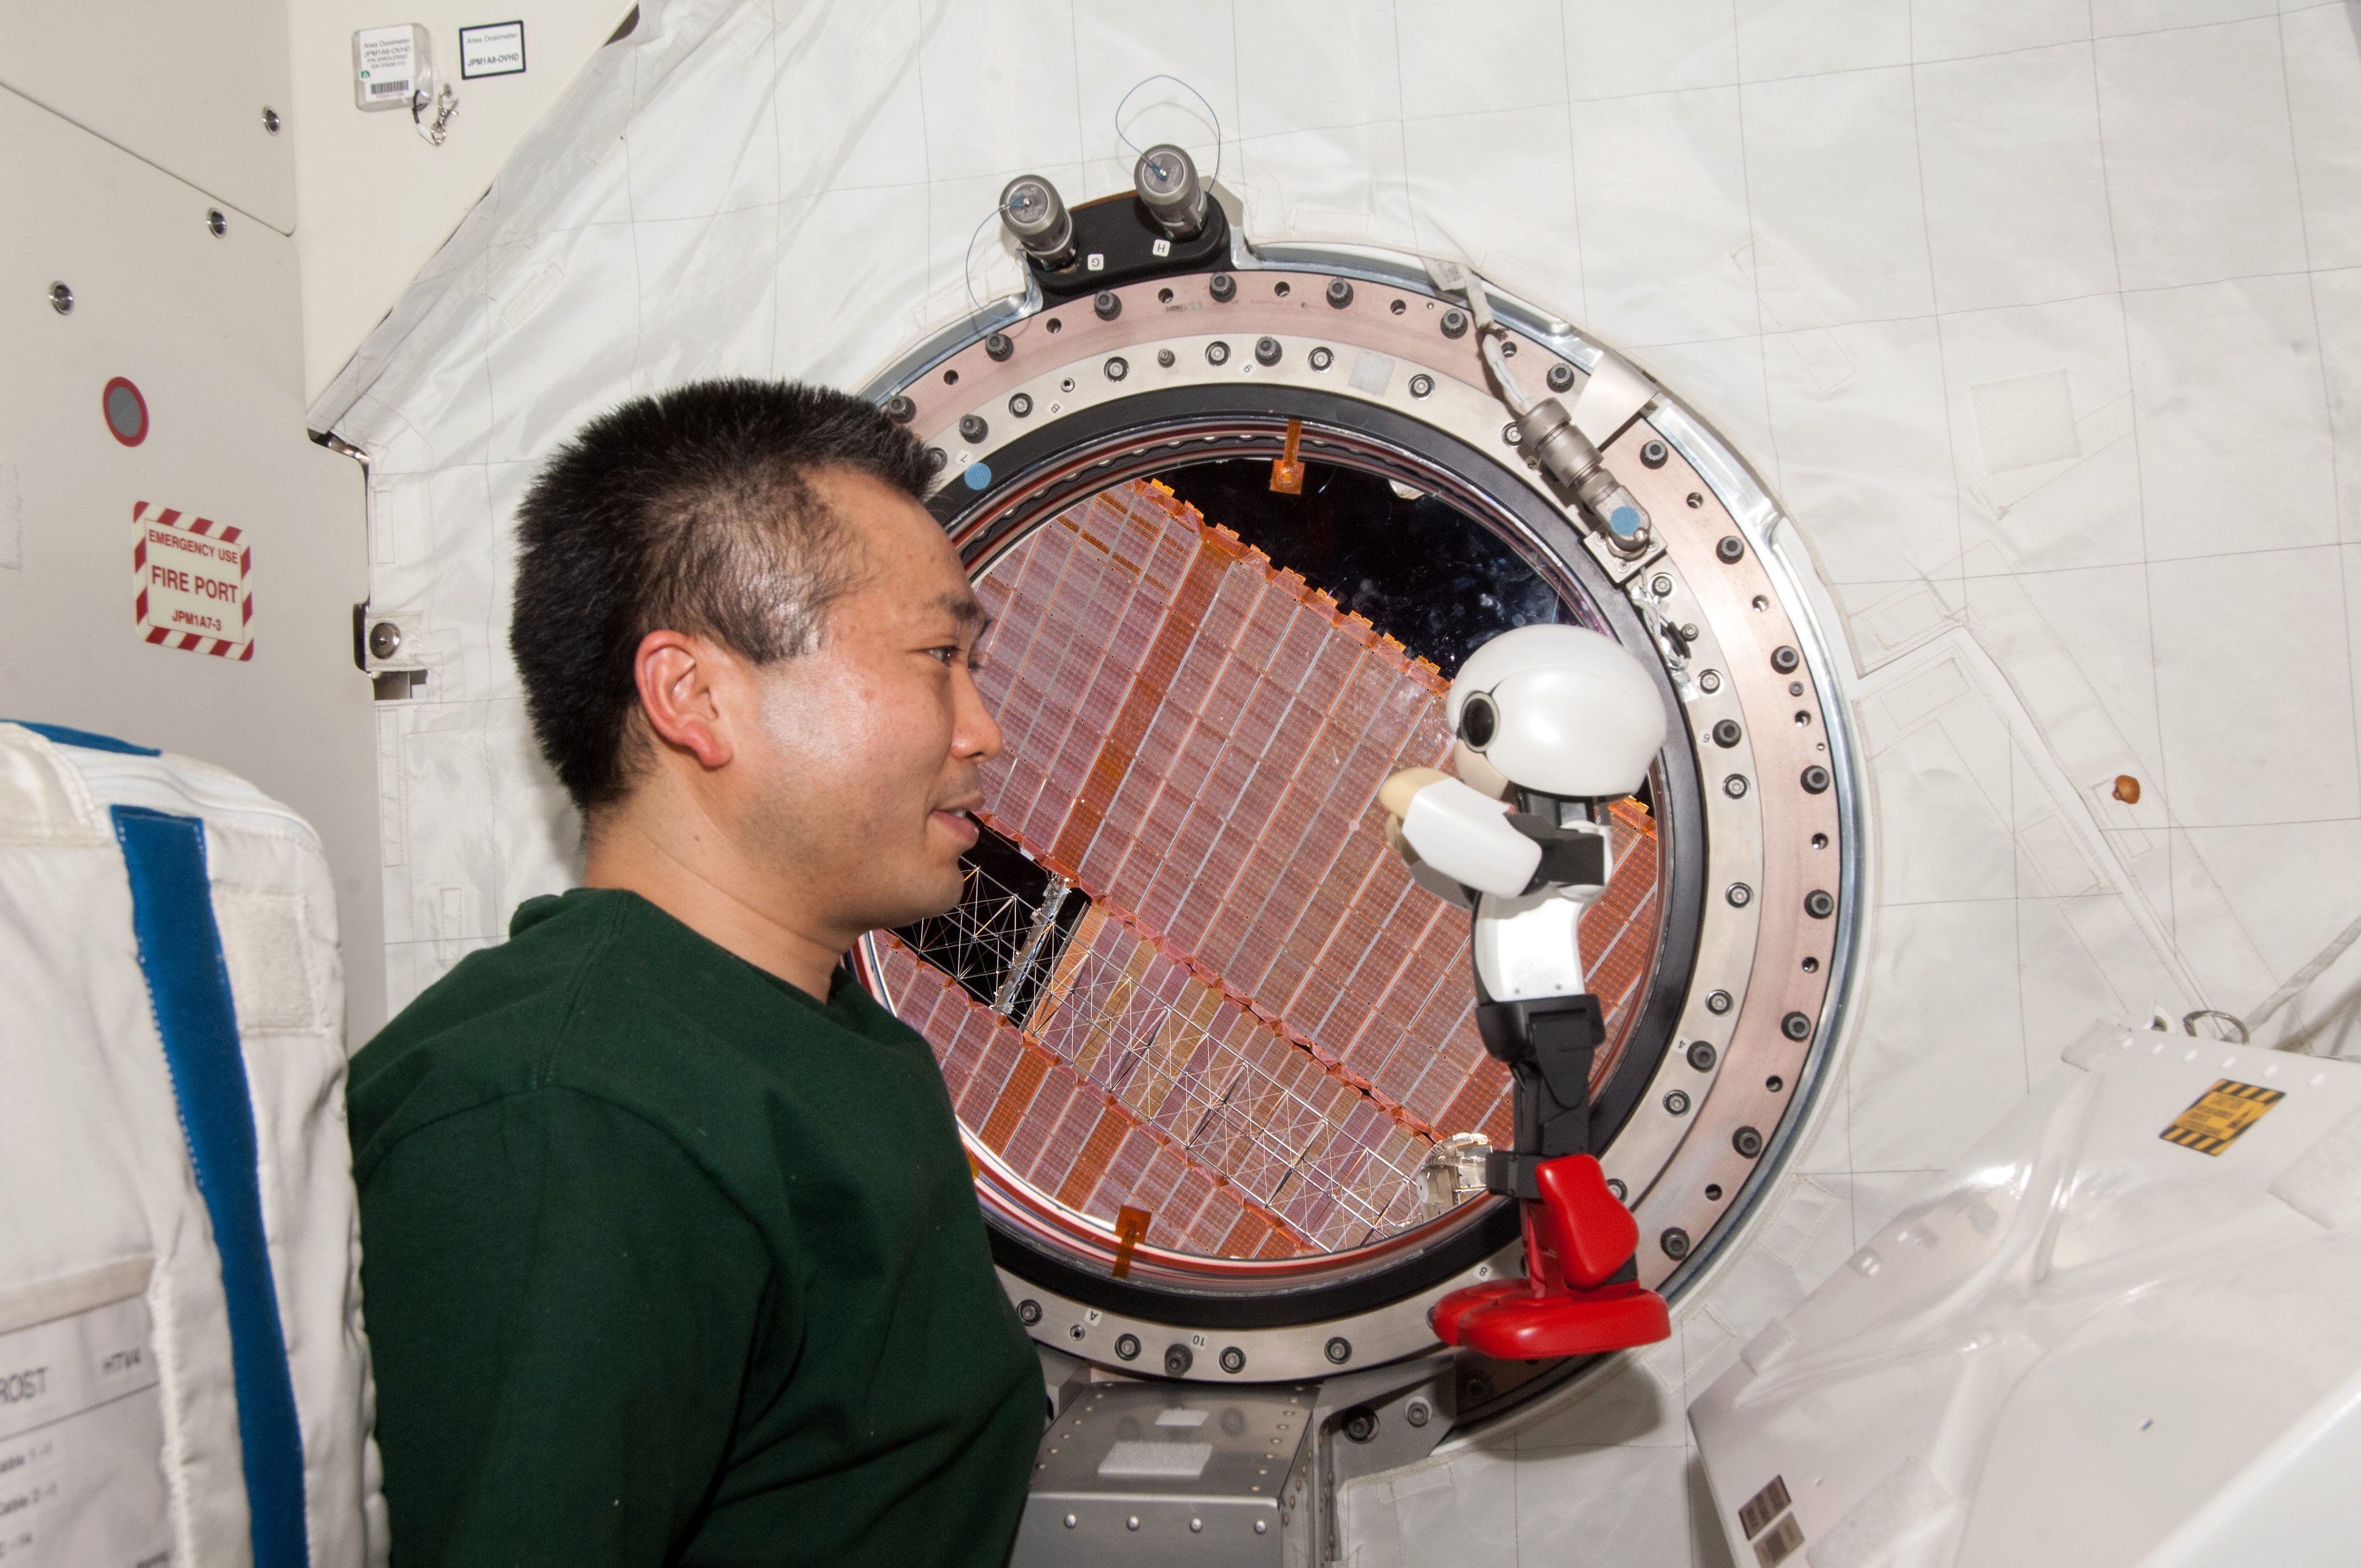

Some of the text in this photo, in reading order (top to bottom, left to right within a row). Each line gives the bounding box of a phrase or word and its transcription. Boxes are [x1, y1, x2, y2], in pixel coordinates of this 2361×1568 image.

[484, 33, 518, 42] Dosimeter
[379, 39, 410, 47] Dosimeter
[467, 52, 519, 67] JPM1A8-OVHD
[1157, 243, 1166, 252] H
[1091, 258, 1100, 267] G
[960, 454, 967, 463] 7
[149, 529, 239, 565] EMERGENCY USE
[151, 565, 238, 604] FIRE PORT
[172, 609, 222, 631] JPM1A7-3
[1678, 1040, 1687, 1049] 4
[1479, 1267, 1488, 1276] 8
[1090, 1310, 1099, 1321] A
[1193, 1335, 1205, 1346] 10
